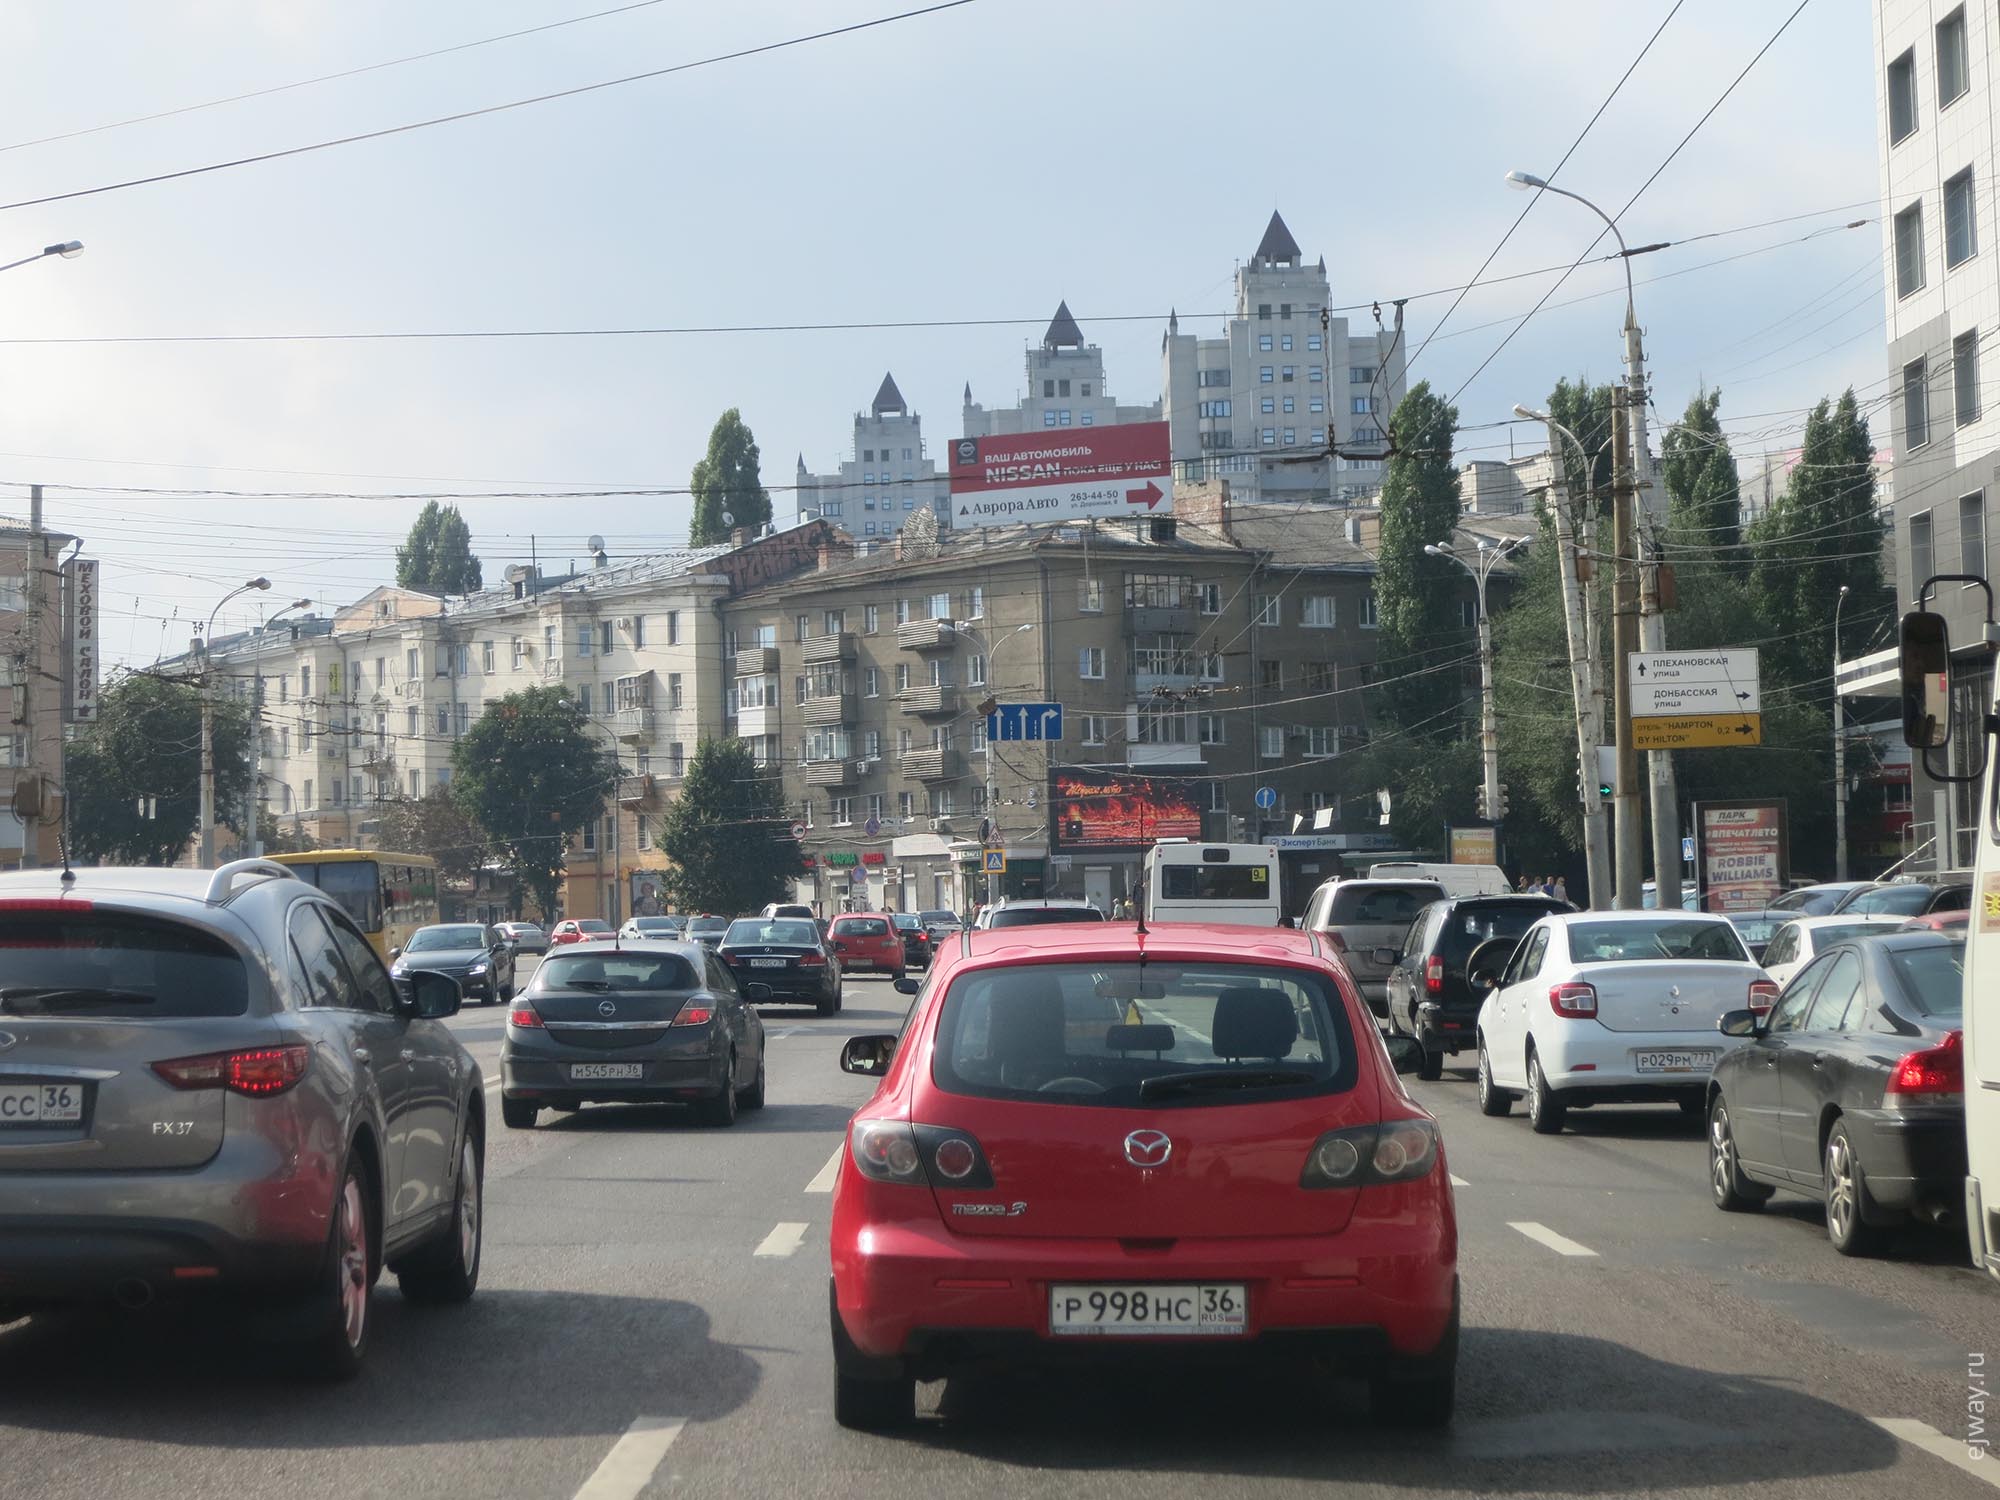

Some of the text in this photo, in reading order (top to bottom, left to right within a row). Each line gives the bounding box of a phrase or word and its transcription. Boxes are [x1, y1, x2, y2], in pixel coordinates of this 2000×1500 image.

[984, 453, 1010, 463] ВАШ
[1012, 446, 1092, 461] АВТОМОБИЛЬ
[985, 462, 1060, 483] NISSAN
[1070, 489, 1119, 502] 263-44-50
[77, 562, 94, 700] МЕХОВОЙ САЛОН
[1653, 657, 1729, 668] ПЛЕХАНОВСКАЯ
[1654, 688, 1718, 699] ДОНБАССКАЯ
[1654, 700, 1682, 709] улица
[1637, 736, 1650, 744] BY
[1718, 810, 1747, 820] ПАРК
[1717, 855, 1766, 869] ROBBIE
[1711, 867, 1774, 882] WILLIAMS
[44, 1087, 72, 1108] 36
[1203, 1289, 1235, 1313] 36
[1201, 1313, 1225, 1322] RUS
